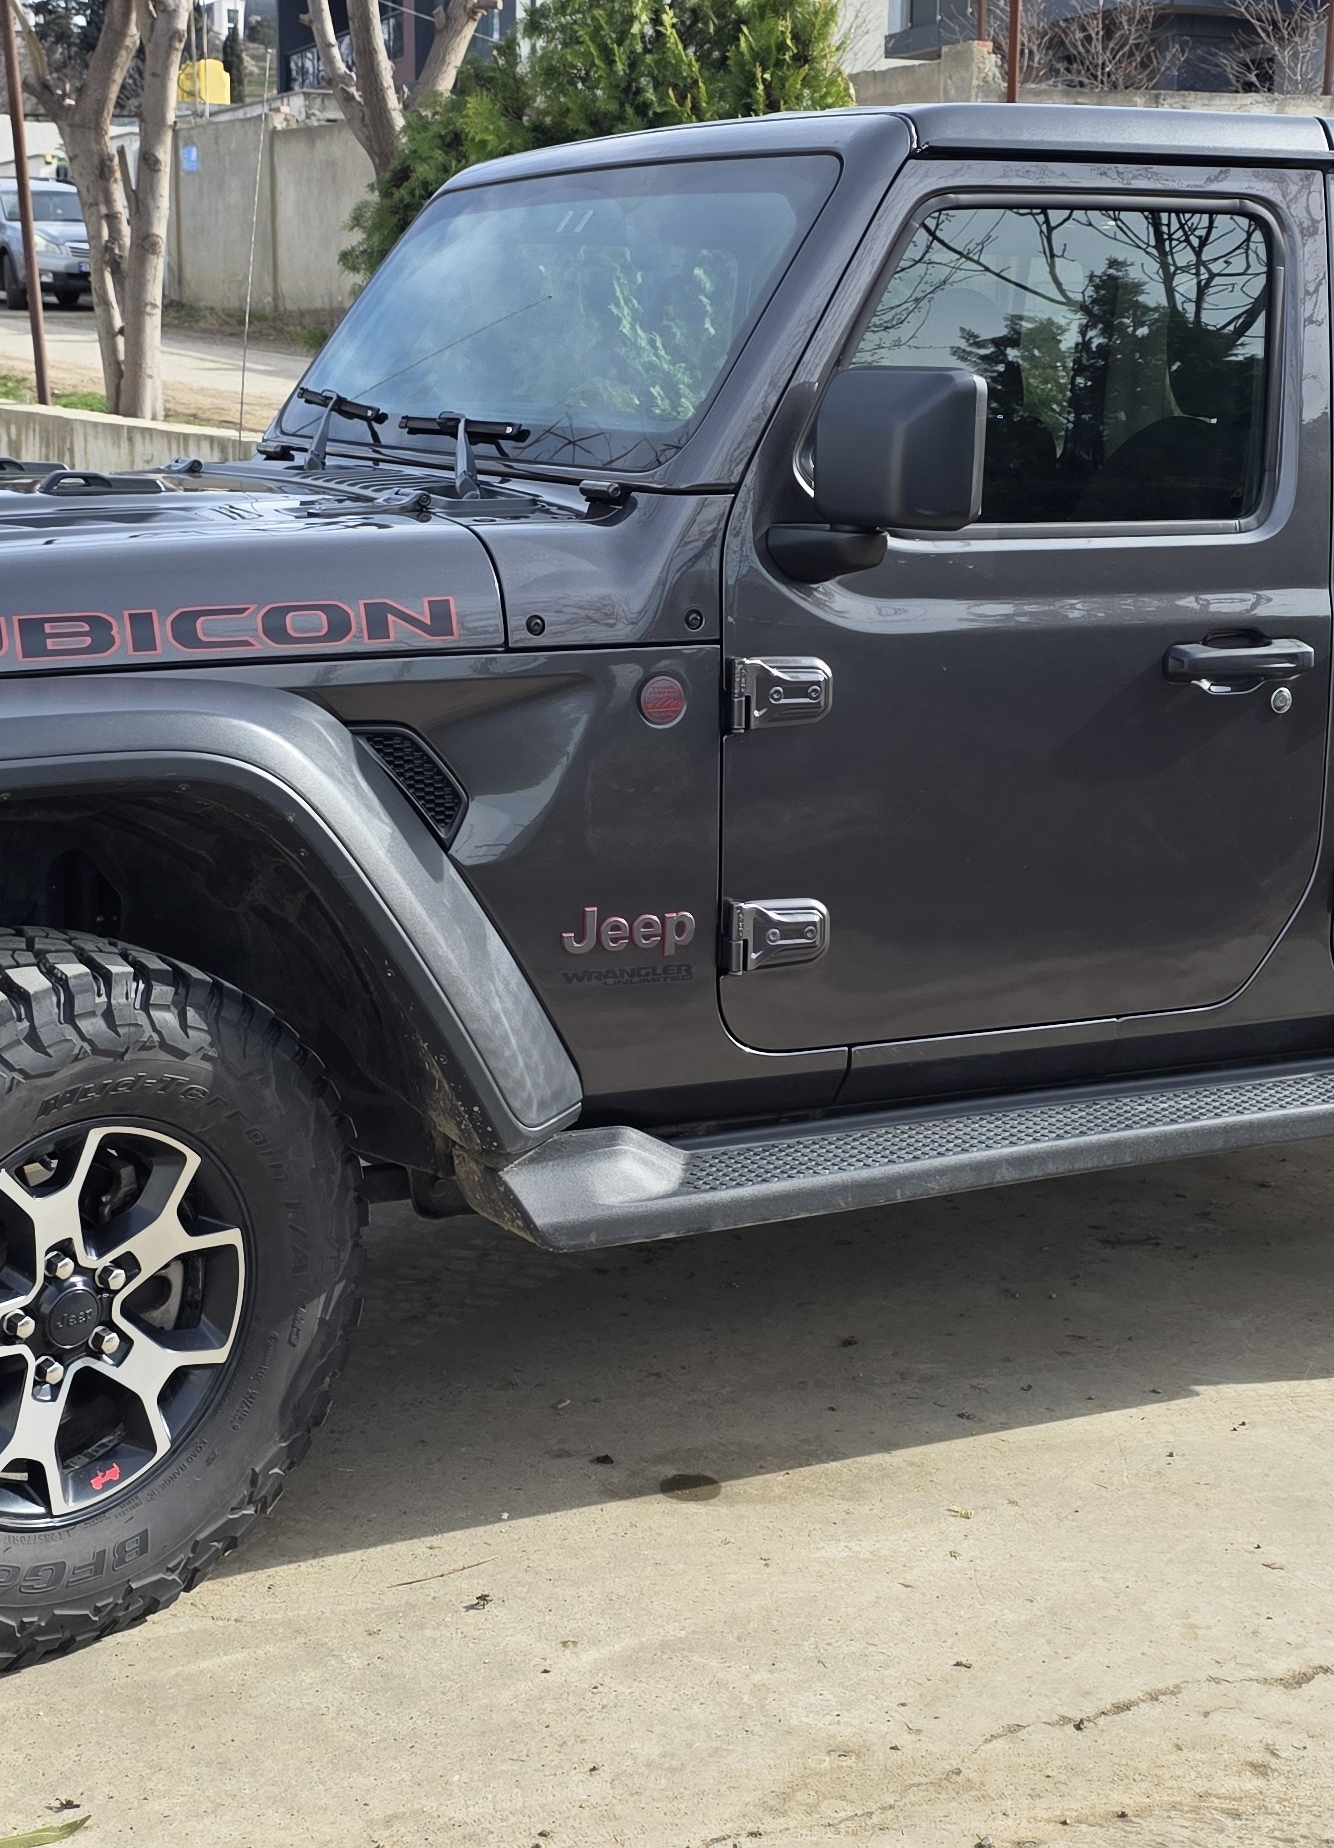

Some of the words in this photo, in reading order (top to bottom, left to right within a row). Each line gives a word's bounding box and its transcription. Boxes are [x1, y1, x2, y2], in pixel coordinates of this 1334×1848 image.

[560, 905, 696, 957] Jeep
[562, 963, 694, 985] WRANGLER
[603, 974, 694, 987] UNLIMITED
[33, 1071, 291, 1185] Mud-Terrain
[55, 1307, 94, 1330] Jeep
